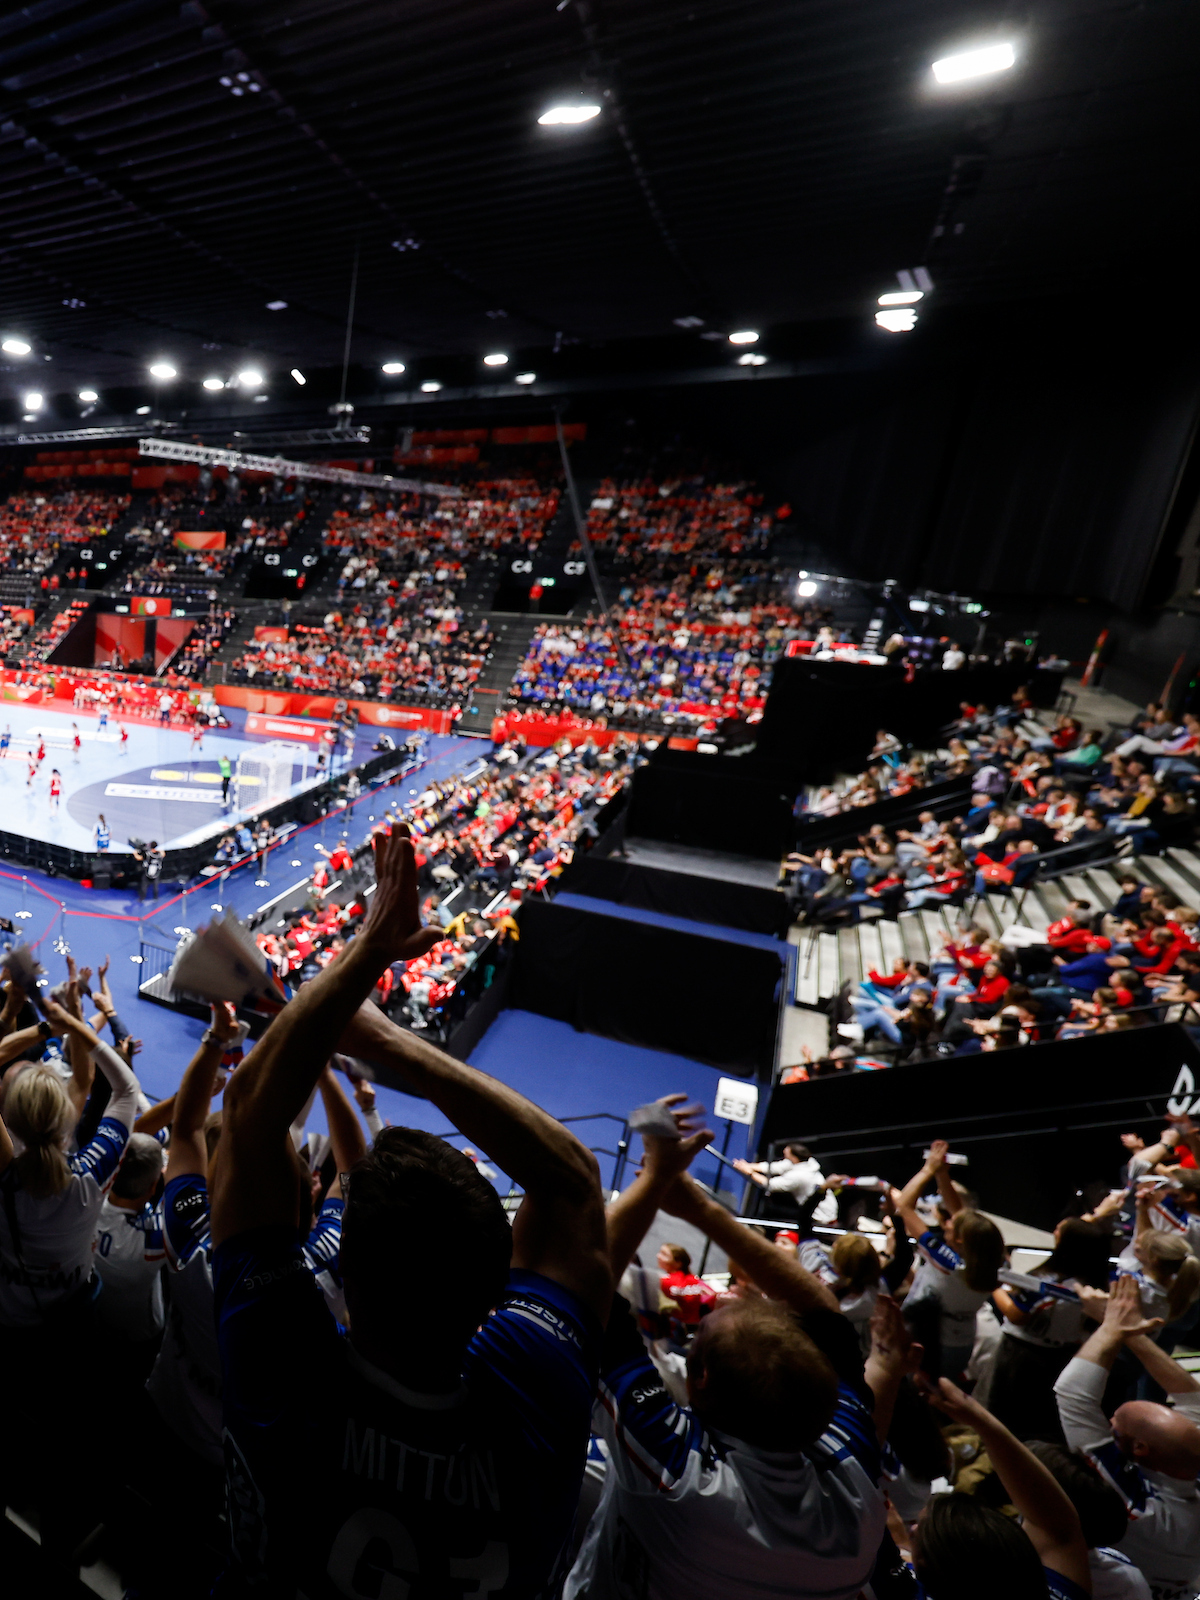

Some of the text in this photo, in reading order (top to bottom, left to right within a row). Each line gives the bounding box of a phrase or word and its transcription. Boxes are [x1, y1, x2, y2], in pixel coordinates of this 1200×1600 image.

[264, 553, 281, 566] C3
[511, 559, 533, 574] C4
[720, 1098, 749, 1118] E3
[341, 1417, 501, 1512] MITTÚN
